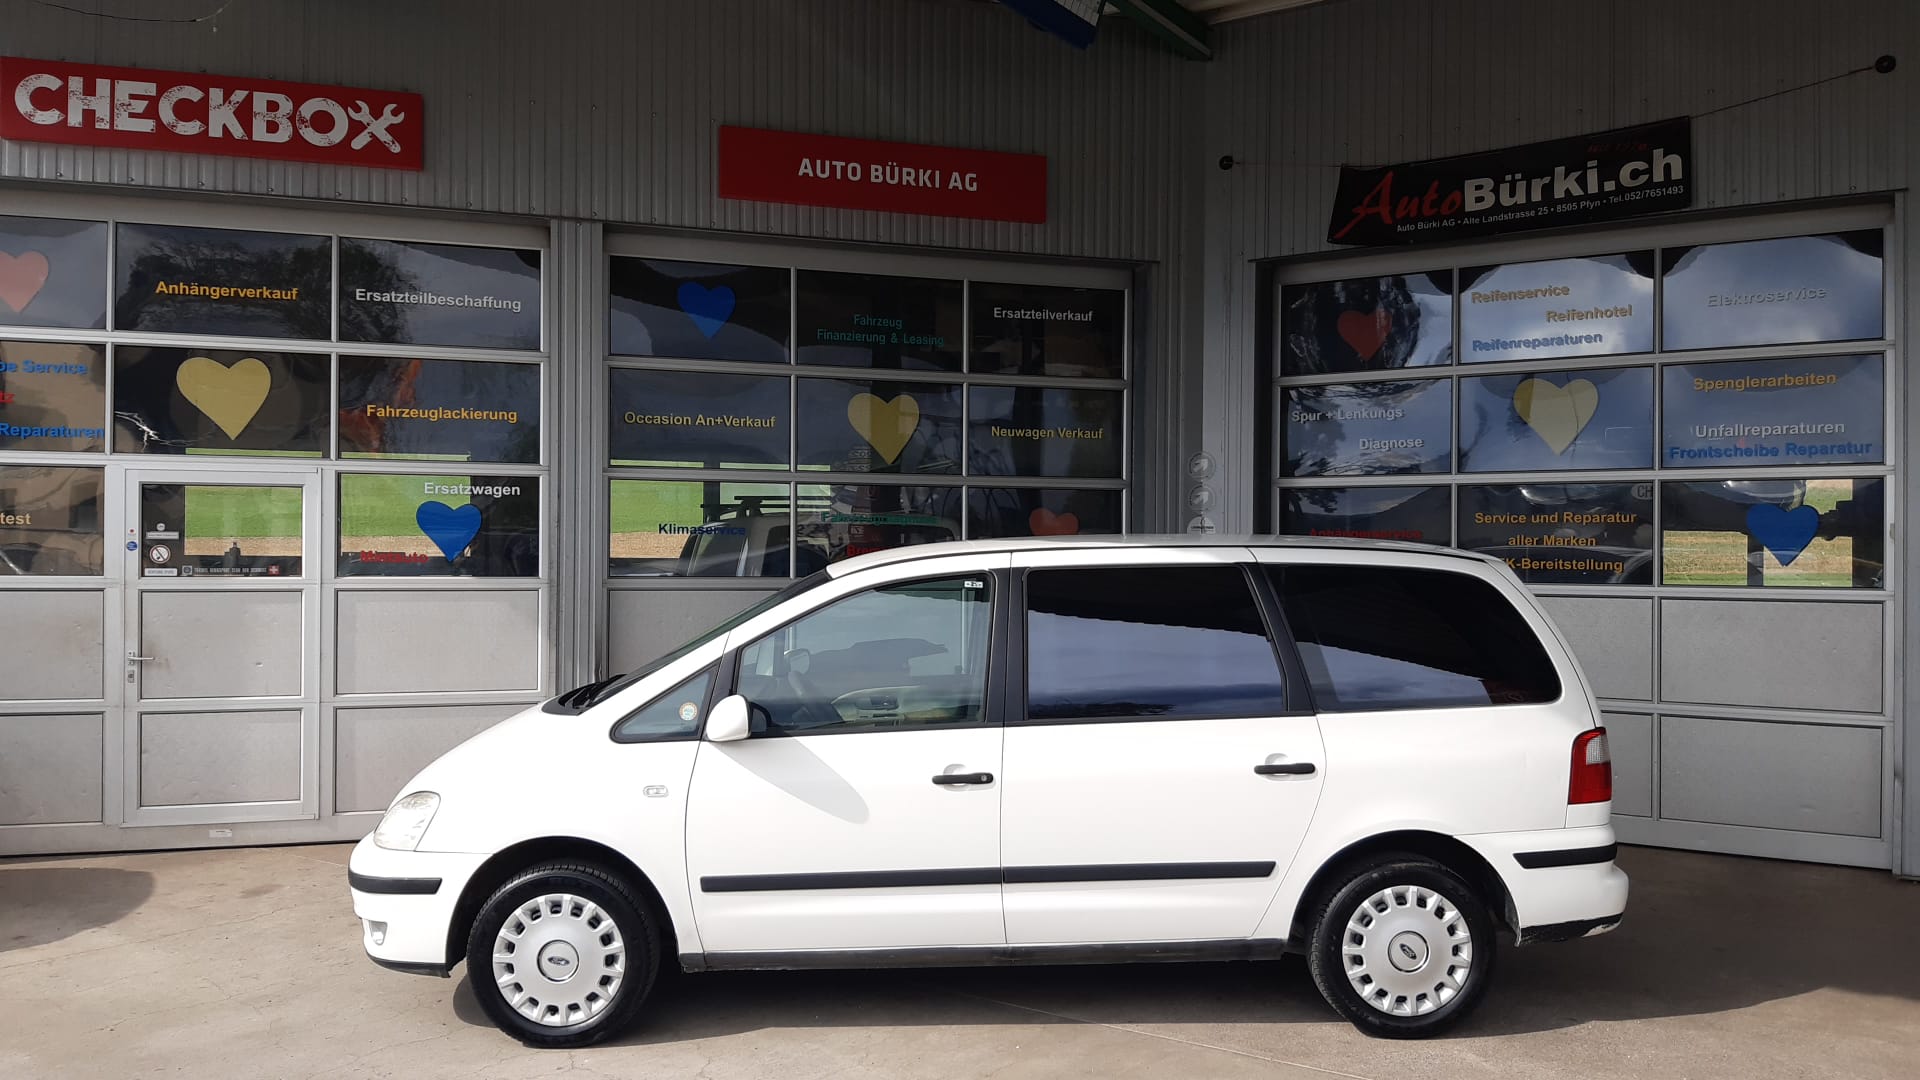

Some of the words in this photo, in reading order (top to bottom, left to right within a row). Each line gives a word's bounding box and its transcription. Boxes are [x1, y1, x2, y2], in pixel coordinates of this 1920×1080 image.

[798, 158, 861, 181] AUTO
[871, 162, 940, 188] BÜRKI
[948, 172, 978, 192] AG
[1396, 223, 1416, 233] Auto
[1417, 219, 1440, 231] Bürki
[1441, 218, 1455, 228] AG
[1462, 215, 1480, 226] Alte
[1482, 208, 1536, 223] Landstrasse
[1537, 206, 1549, 216] 25
[1556, 203, 1578, 213] 8505
[1580, 199, 1601, 212] Pfyn
[155, 280, 299, 300] Anhängerverkauf
[1471, 285, 1570, 303] Reifenservice
[1707, 287, 1827, 308] Elektroservice
[355, 288, 522, 313] Ersatzteilbeschaffung
[853, 314, 903, 330] Fahrzeug
[993, 307, 1093, 322] Ersatzteilverkauf
[1546, 304, 1633, 323] Reifenhotel
[817, 328, 886, 345] Finanzierung
[891, 333, 898, 344] &
[903, 333, 944, 347] Leasing
[1472, 331, 1603, 352] Reifenreparaturen
[22, 359, 88, 375] Service
[1693, 372, 1838, 392] Spenglerarbeiten
[366, 404, 518, 424] Fahrzeuglackierung
[624, 411, 691, 426] Occasion
[695, 413, 776, 429] An+Verkauf
[1291, 410, 1321, 425] Spur
[1337, 407, 1404, 423] Lenkungs
[0, 422, 105, 439] Reparaturen
[991, 425, 1054, 440] Neuwagen
[1058, 427, 1104, 440] Verkauf
[1695, 422, 1845, 439] Unfallreparaturen
[1359, 437, 1424, 452] Diagnose
[1669, 443, 1779, 460] Frontscheibe
[1785, 441, 1872, 459] Reparatur
[424, 482, 521, 498] Ersatzwagen
[0, 512, 32, 525] test
[1474, 511, 1527, 525] Service
[1531, 512, 1559, 525] und
[1563, 511, 1637, 526] Reparatur
[658, 523, 746, 536] Klimaservice
[1508, 534, 1539, 547] aller
[1542, 535, 1596, 548] Marken
[1503, 557, 1624, 574] K-Bereitstellung
